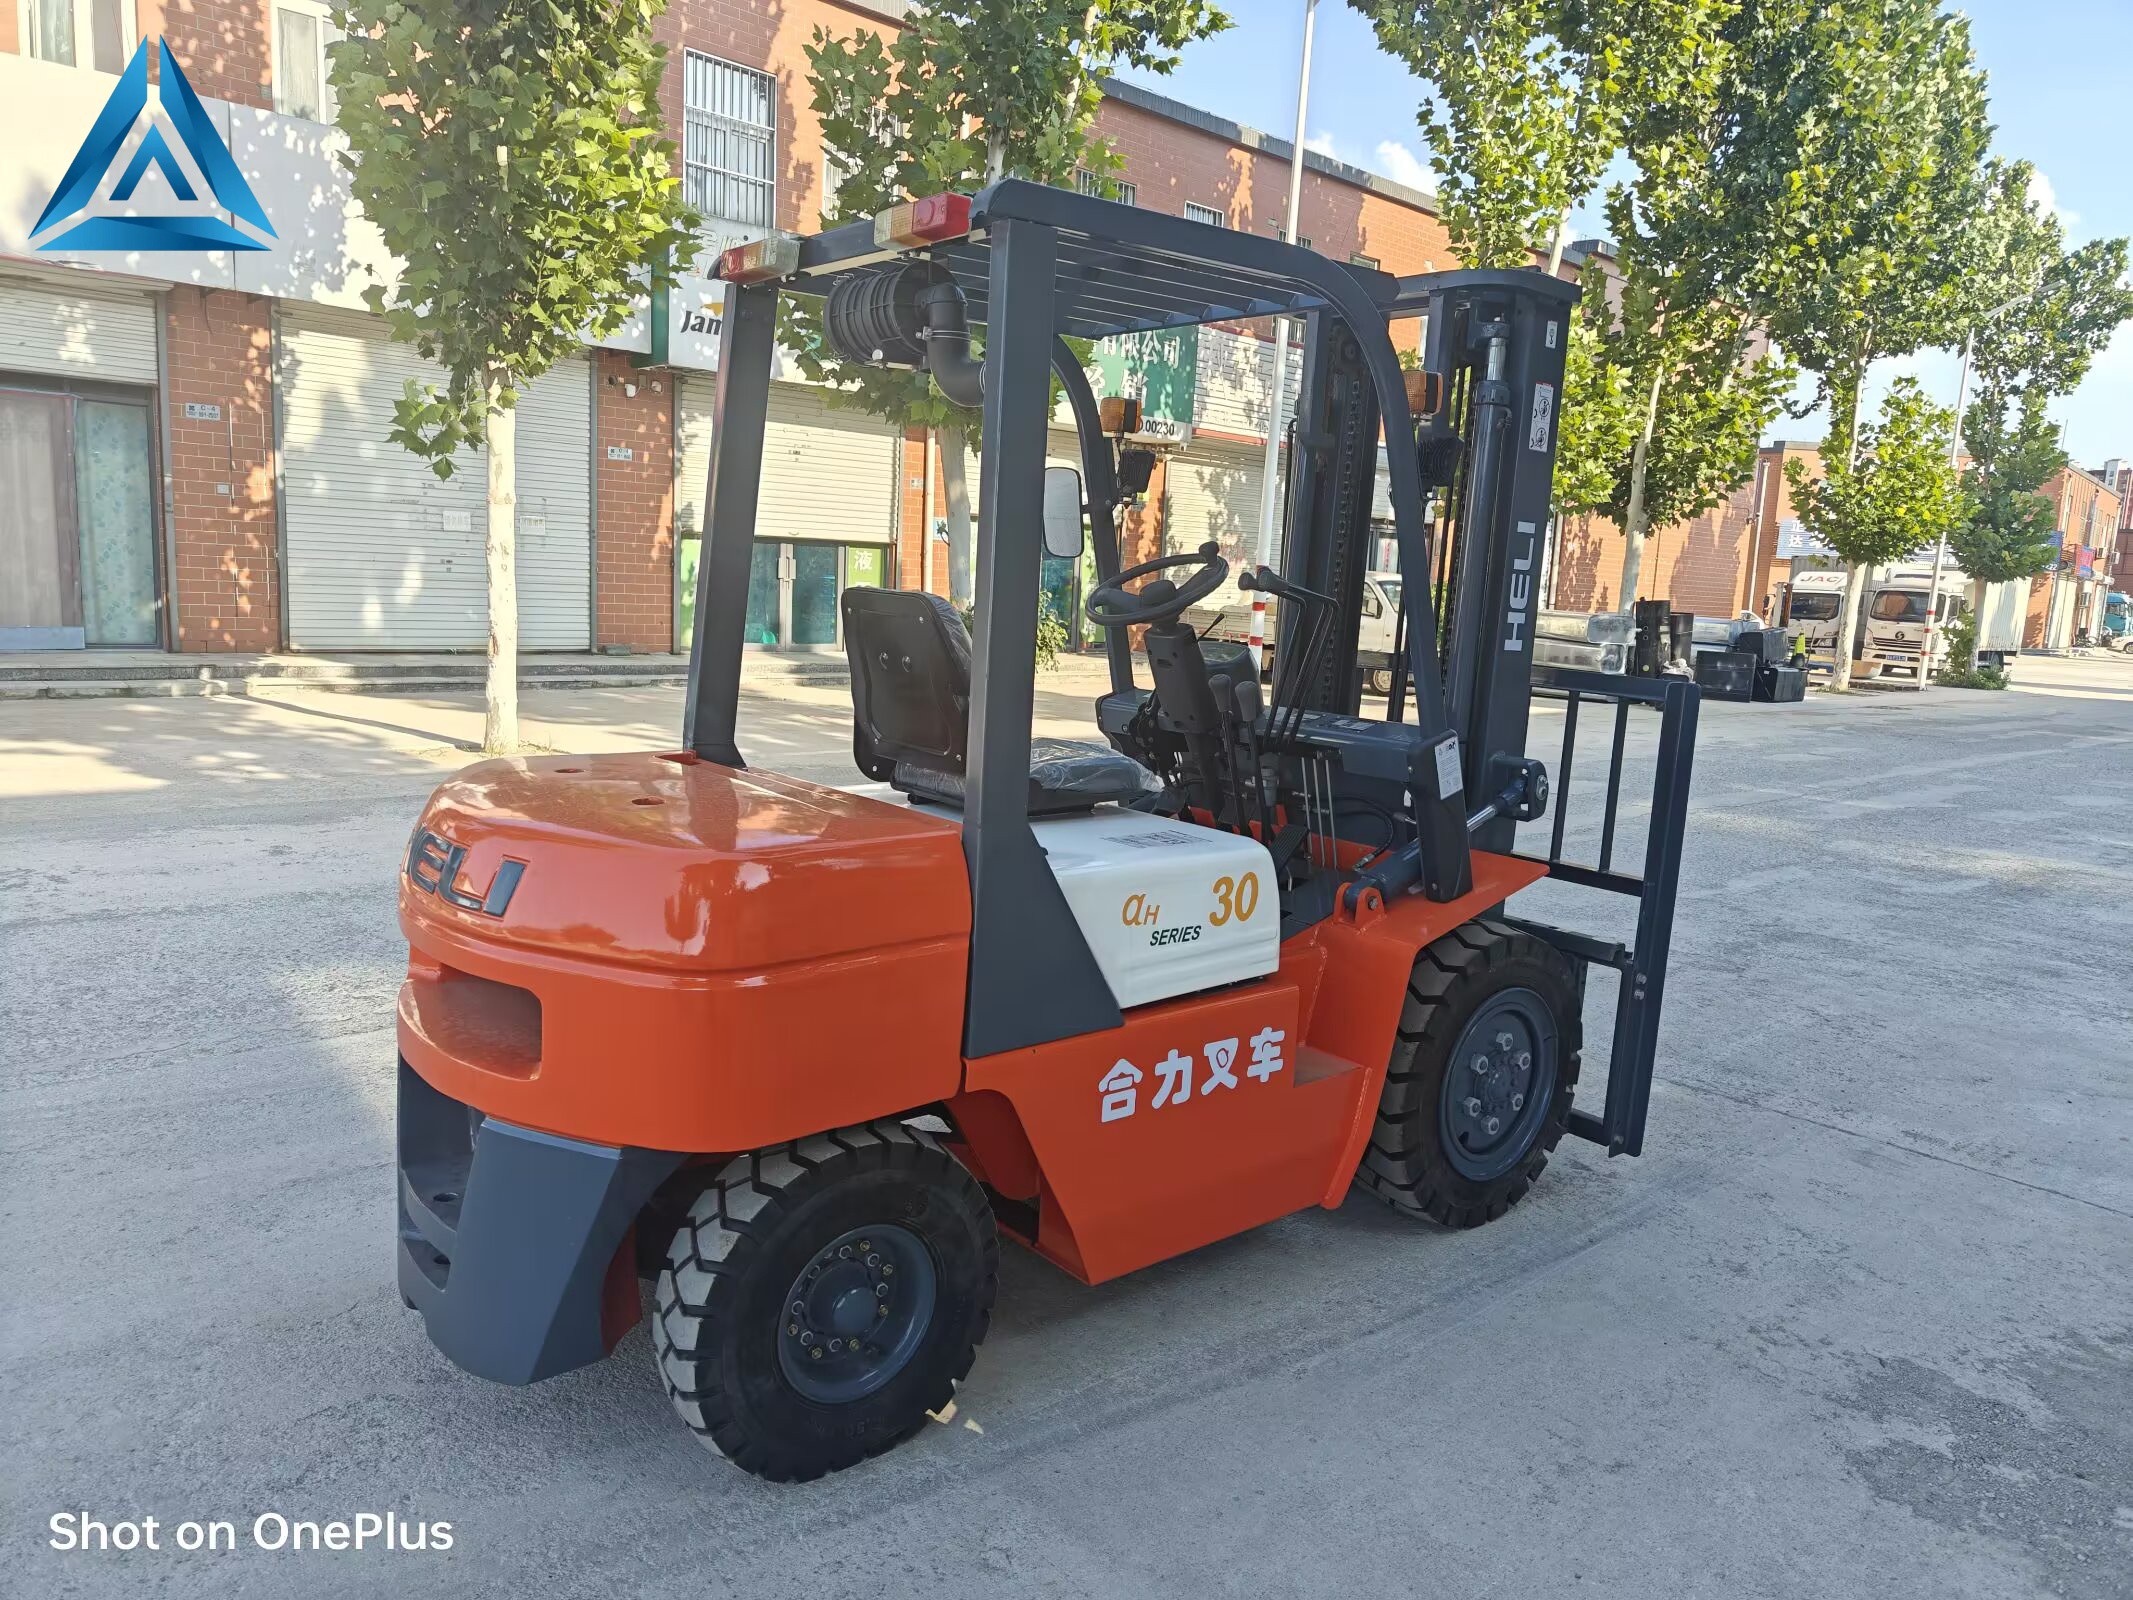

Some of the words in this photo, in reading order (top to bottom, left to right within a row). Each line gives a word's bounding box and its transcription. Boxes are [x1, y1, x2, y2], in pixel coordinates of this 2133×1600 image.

[1504, 521, 1536, 651] HELI
[1150, 925, 1202, 946] SERIES
[1209, 872, 1259, 927] 30
[1098, 1027, 1285, 1123] 合力叉车
